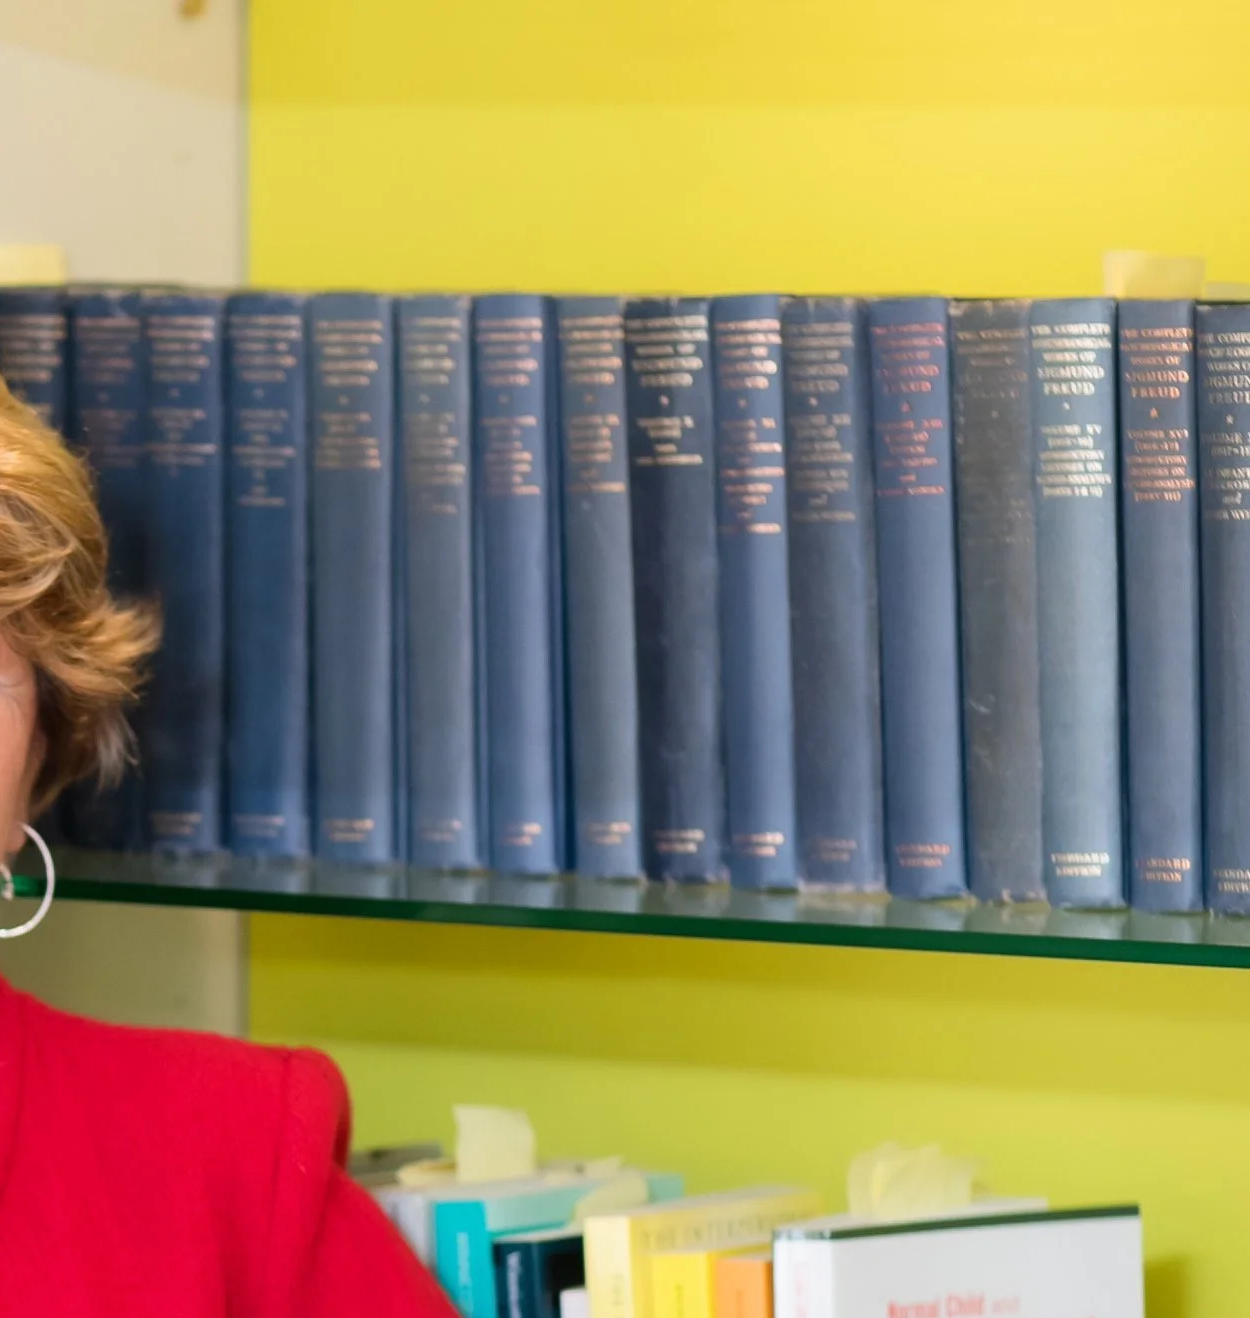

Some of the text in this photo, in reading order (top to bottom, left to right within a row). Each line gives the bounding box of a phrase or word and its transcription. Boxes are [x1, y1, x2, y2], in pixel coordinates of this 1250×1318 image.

[1037, 365, 1105, 379] SIGMUND
[1125, 370, 1190, 383] SIGMUND
[1043, 381, 1095, 396] FREUD
[1131, 386, 1180, 398] FREUD
[1135, 857, 1191, 871] STANDARD
[1140, 871, 1182, 882] EDITION
[946, 1291, 985, 1318] Child
